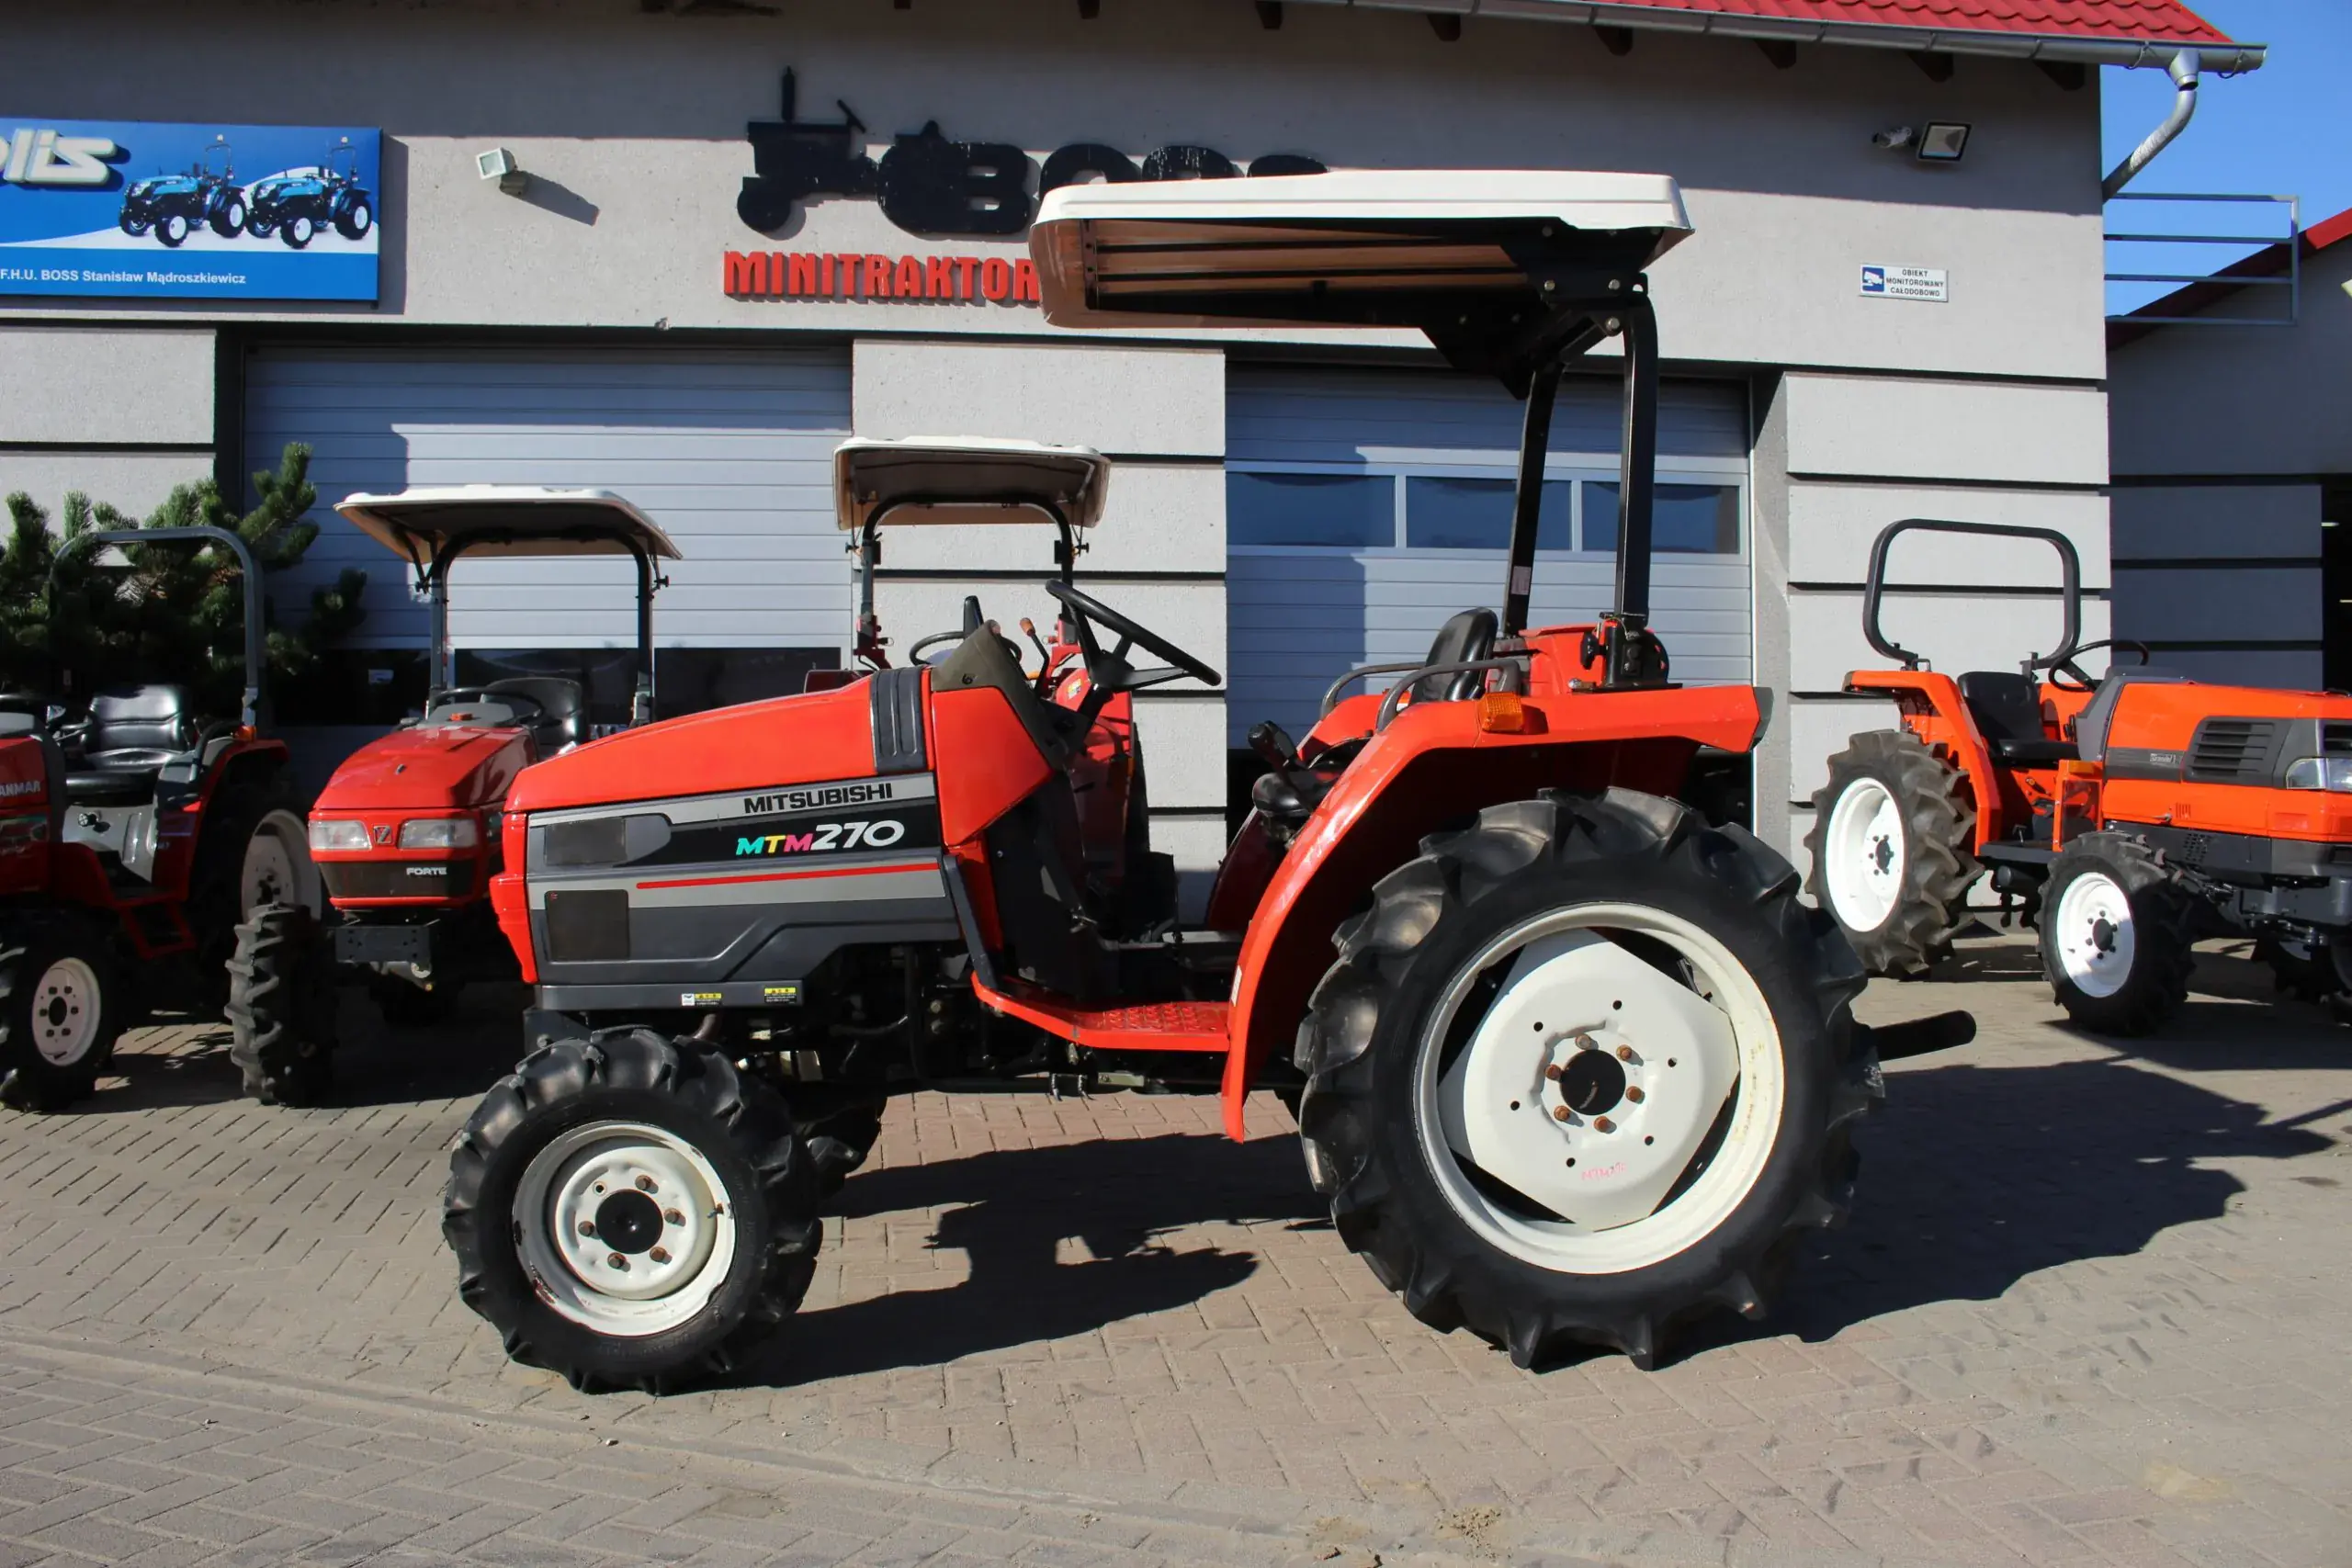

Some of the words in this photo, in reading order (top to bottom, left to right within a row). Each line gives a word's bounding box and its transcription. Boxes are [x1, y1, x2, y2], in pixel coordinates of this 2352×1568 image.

[0, 128, 116, 184] lis
[0, 268, 38, 281] F.H.U.
[40, 269, 80, 282] BOSS
[146, 272, 247, 286] Mądroszkiewicz
[1902, 269, 1928, 277] OBIEKT
[1885, 277, 1944, 288] MONITOROWANY
[1890, 287, 1940, 297] CAŁODOBOWO
[744, 783, 893, 814] MITSUBISHI
[736, 820, 905, 856] MTM270
[406, 867, 447, 875] FORTE
